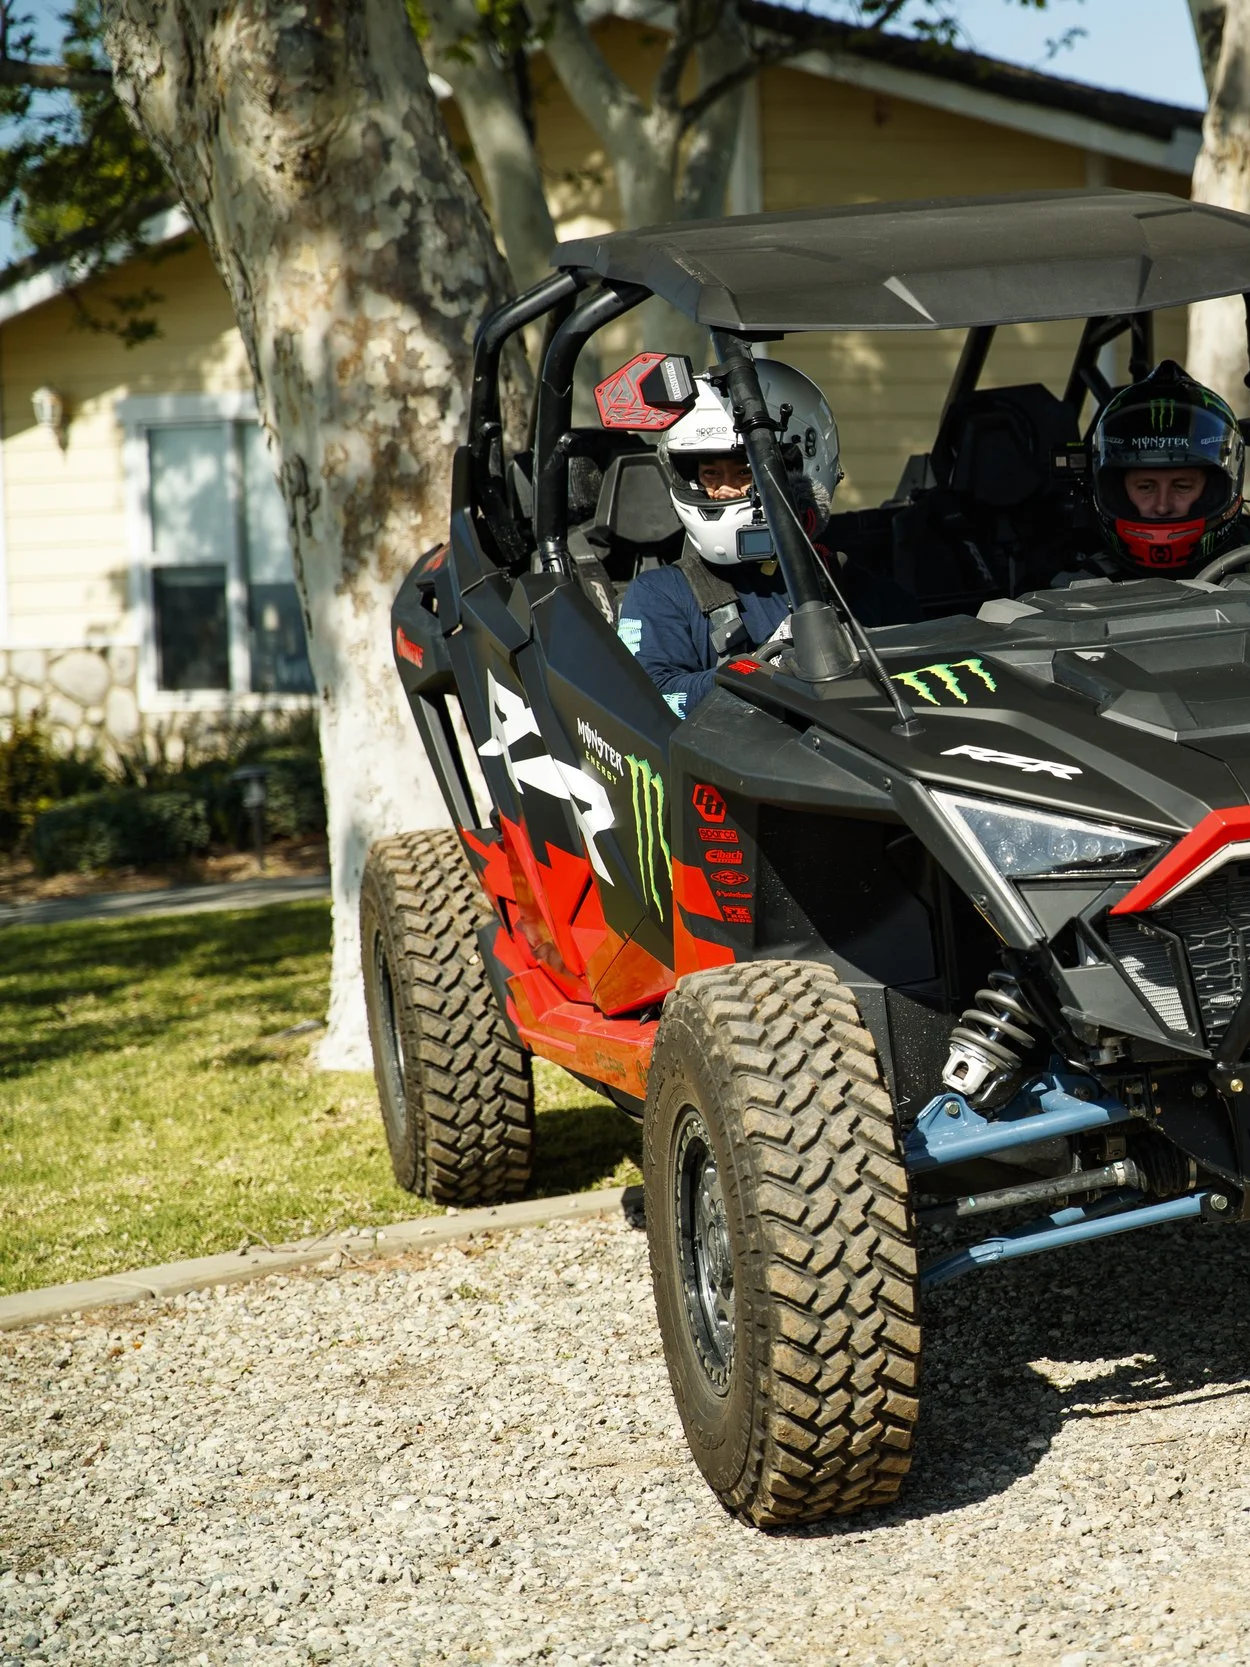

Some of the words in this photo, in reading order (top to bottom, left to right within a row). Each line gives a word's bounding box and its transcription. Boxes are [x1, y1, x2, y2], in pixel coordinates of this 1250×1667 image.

[606, 407, 676, 424] RZR
[696, 426, 728, 436] sparco
[1132, 436, 1190, 449] MONSTER
[576, 716, 624, 777] MONSTER
[585, 752, 618, 786] ENERGY
[940, 744, 1083, 780] RZR
[478, 668, 615, 887] RZR
[700, 829, 736, 839] sparco
